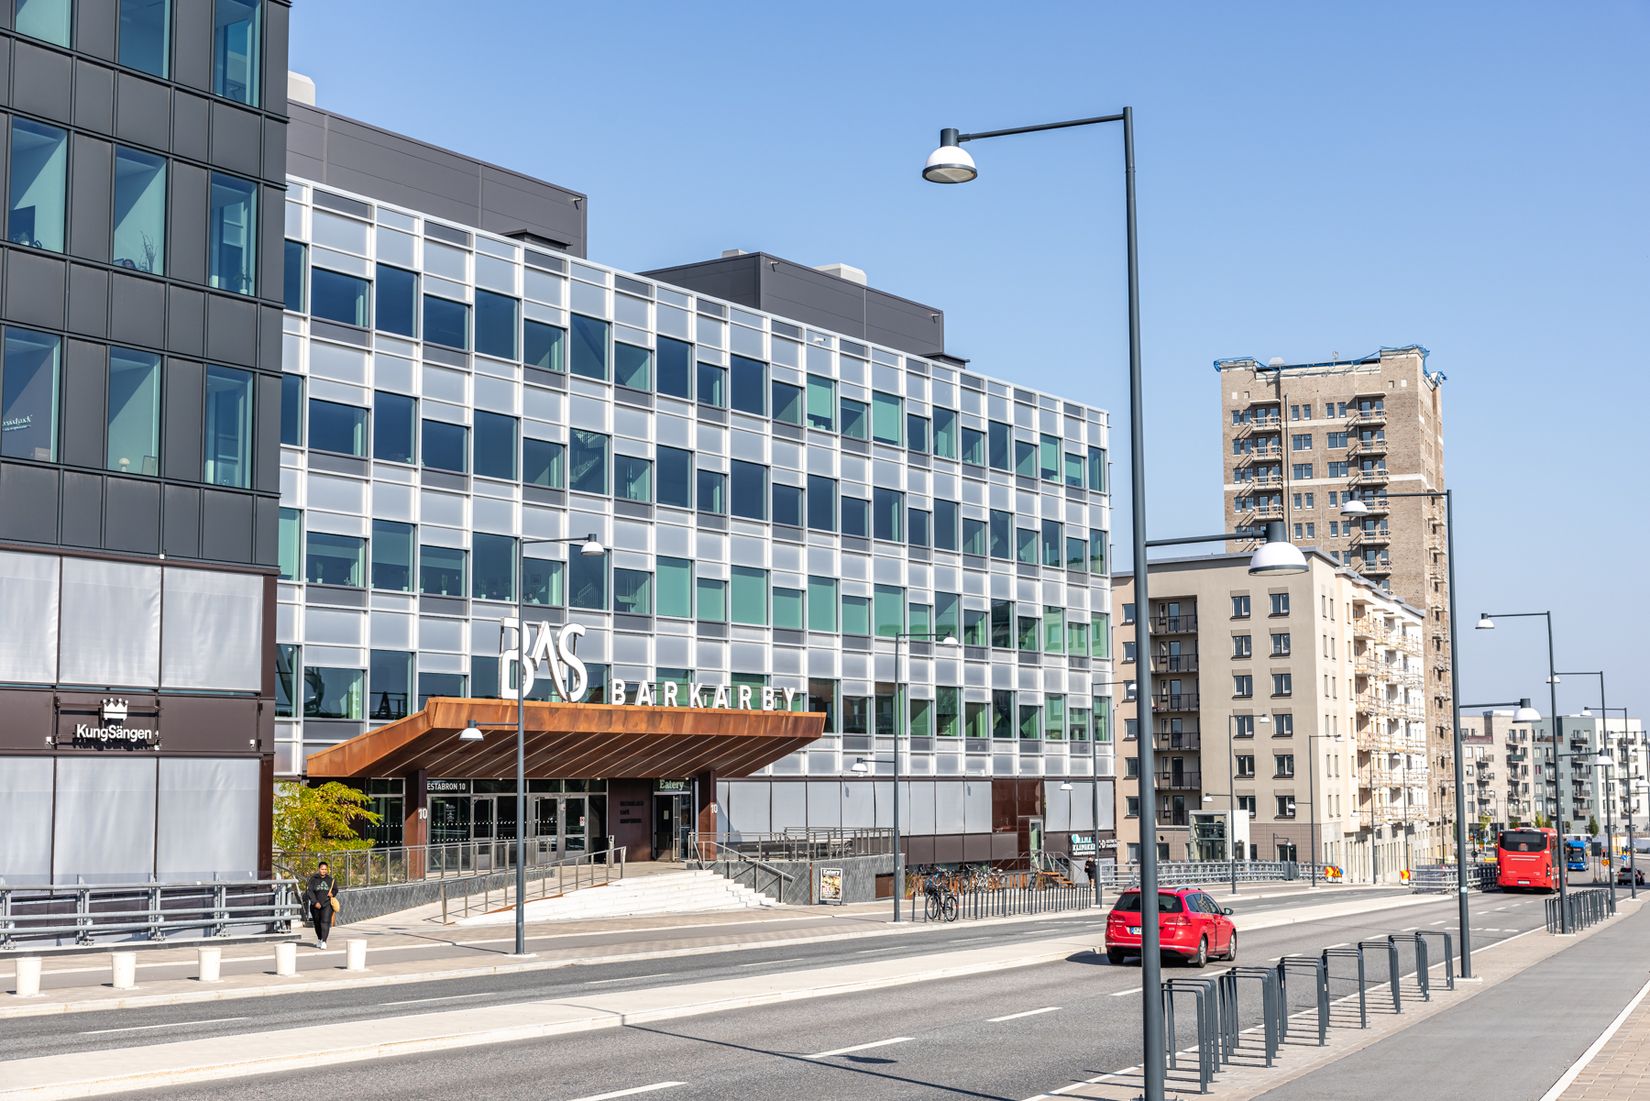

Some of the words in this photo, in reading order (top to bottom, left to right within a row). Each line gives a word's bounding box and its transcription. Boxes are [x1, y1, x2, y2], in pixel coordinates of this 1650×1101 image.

[500, 617, 588, 703] BAS
[611, 678, 796, 712] BARKARBY
[76, 724, 152, 742] KungSängen
[459, 782, 466, 791] 10
[659, 779, 684, 791] Eatery
[418, 808, 428, 819] 10
[710, 804, 718, 814] 10
